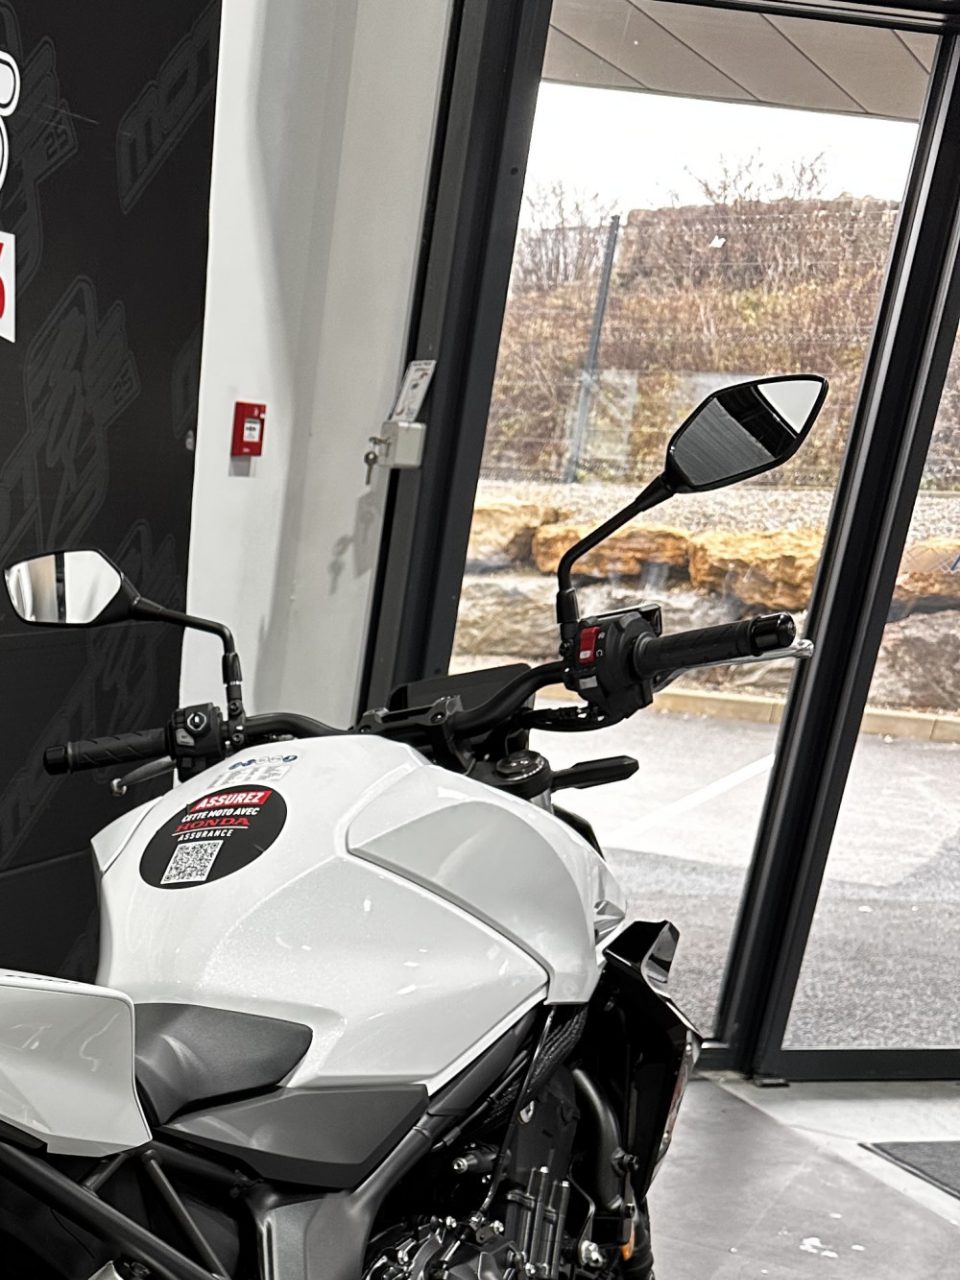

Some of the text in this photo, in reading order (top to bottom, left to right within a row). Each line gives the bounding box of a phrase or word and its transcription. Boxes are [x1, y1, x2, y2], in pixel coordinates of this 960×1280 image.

[197, 792, 264, 809] ASSUREZ
[181, 807, 260, 823] CETTE MOTO AVEC
[175, 818, 250, 831] HONDA
[177, 829, 234, 842] ASSURANCE
